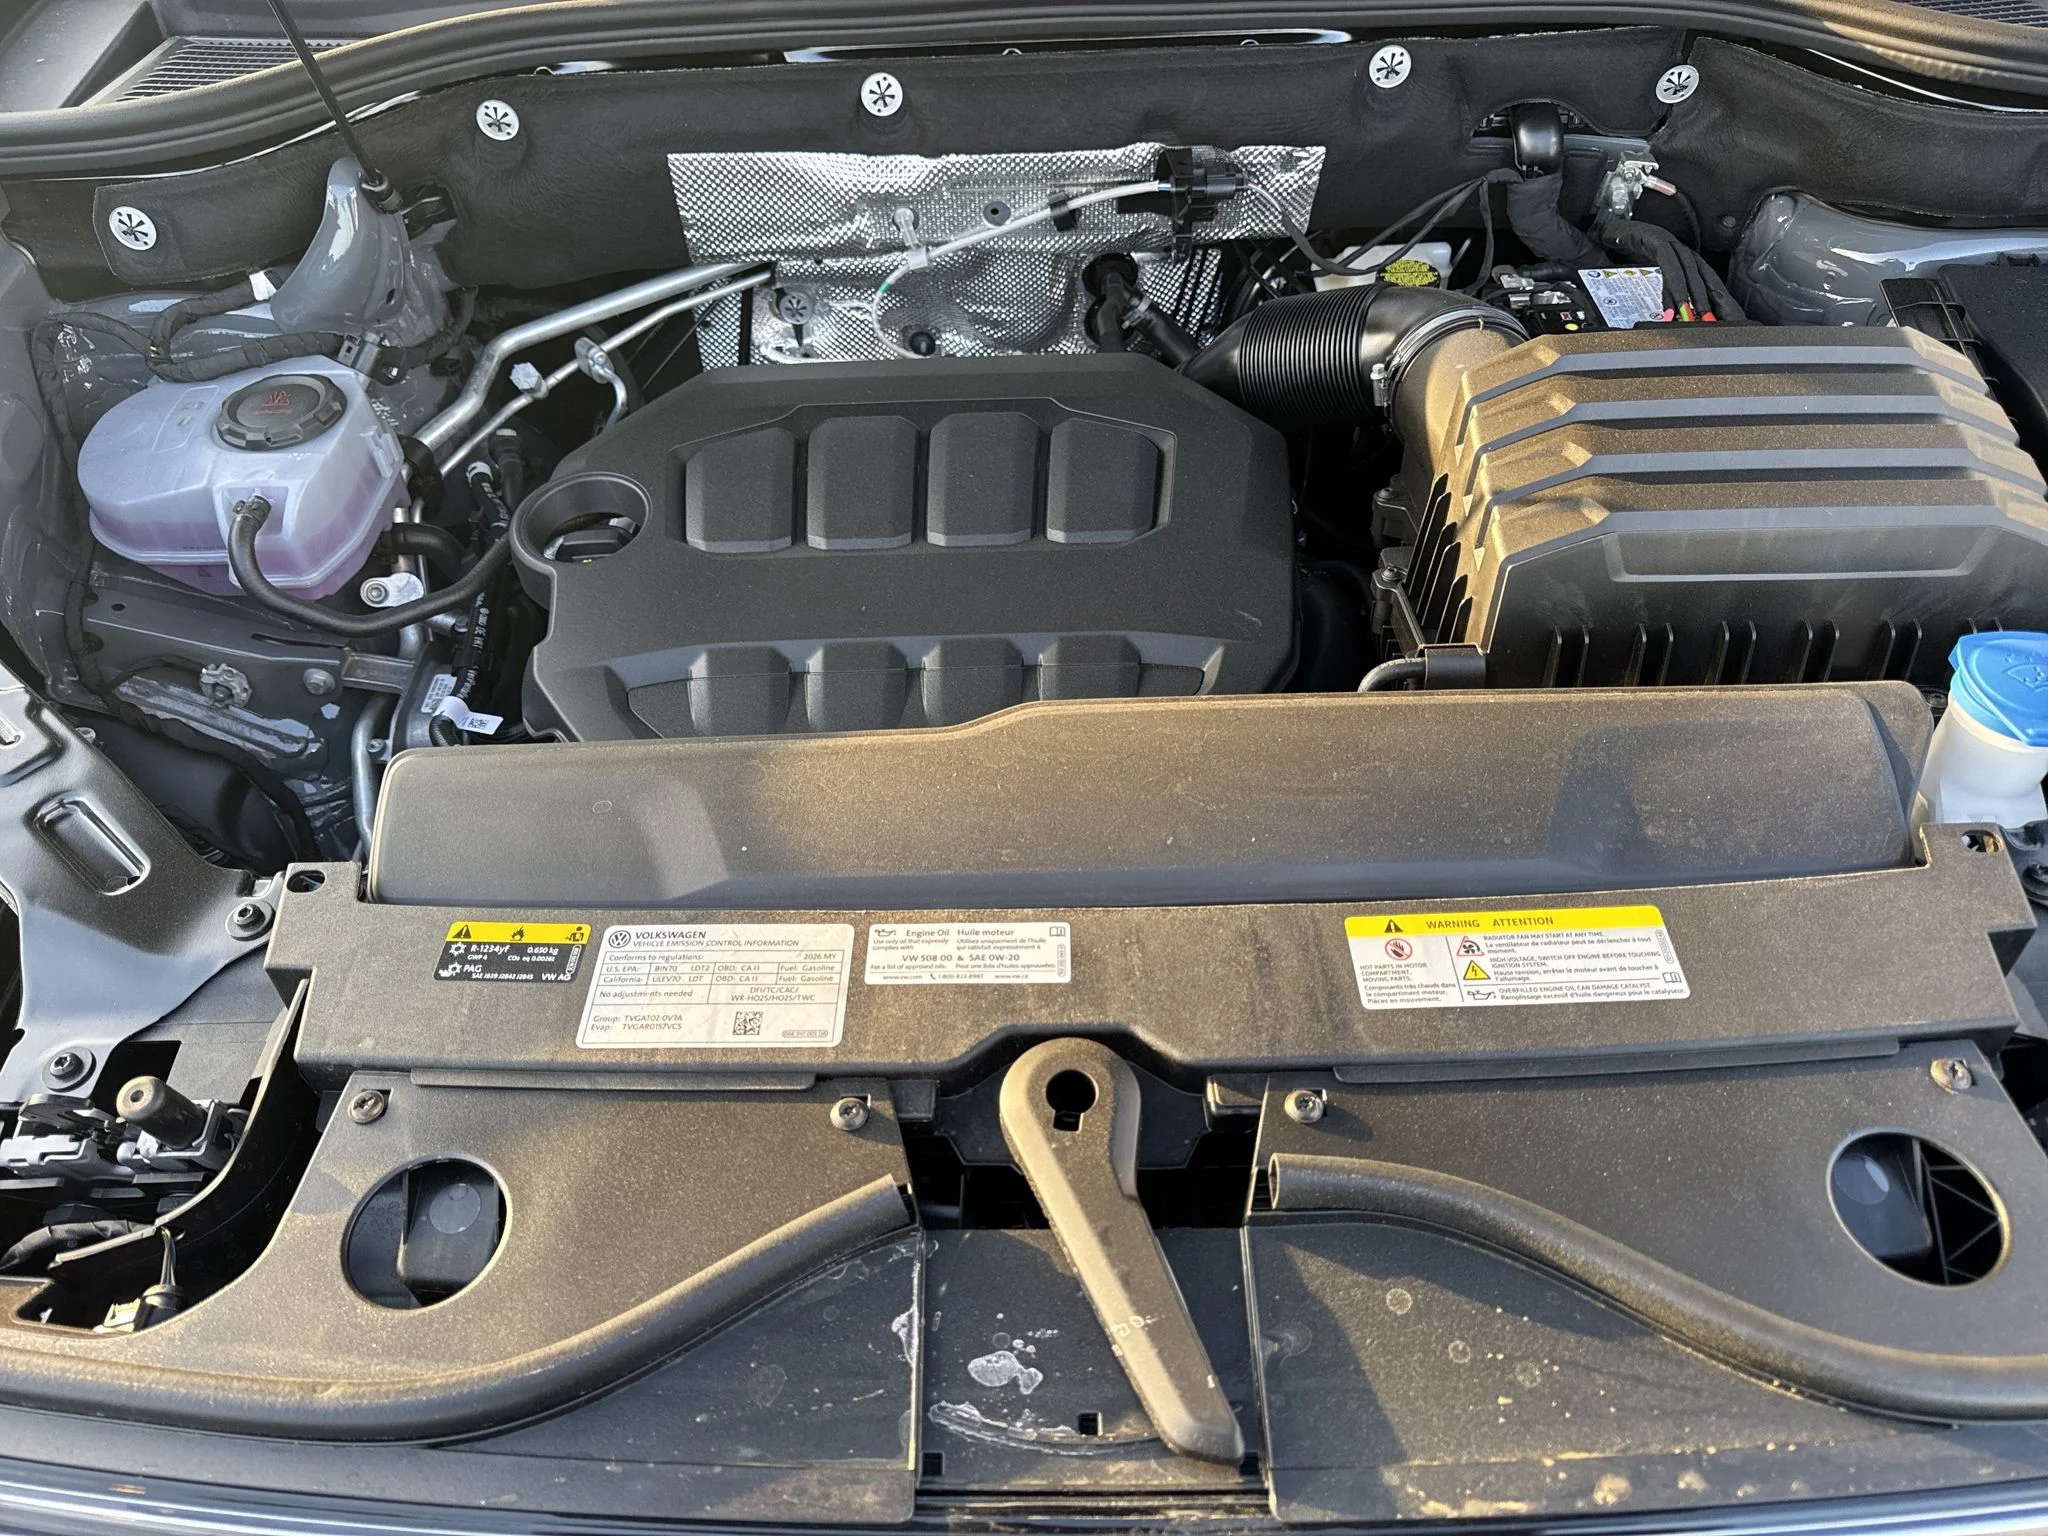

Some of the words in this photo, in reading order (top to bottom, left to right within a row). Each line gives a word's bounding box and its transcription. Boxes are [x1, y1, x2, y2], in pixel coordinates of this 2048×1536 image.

[1425, 919, 1481, 930] WARNING
[1492, 916, 1554, 927] ATTENTION
[635, 931, 707, 940] VOLKSWAGEN
[906, 929, 936, 938] Engine
[957, 928, 980, 936] Huile
[470, 945, 509, 954] R-1234yf
[549, 947, 559, 955] kg
[658, 953, 704, 962] regulations:
[593, 1015, 620, 1023] Group:
[591, 1024, 612, 1032] Evap:
